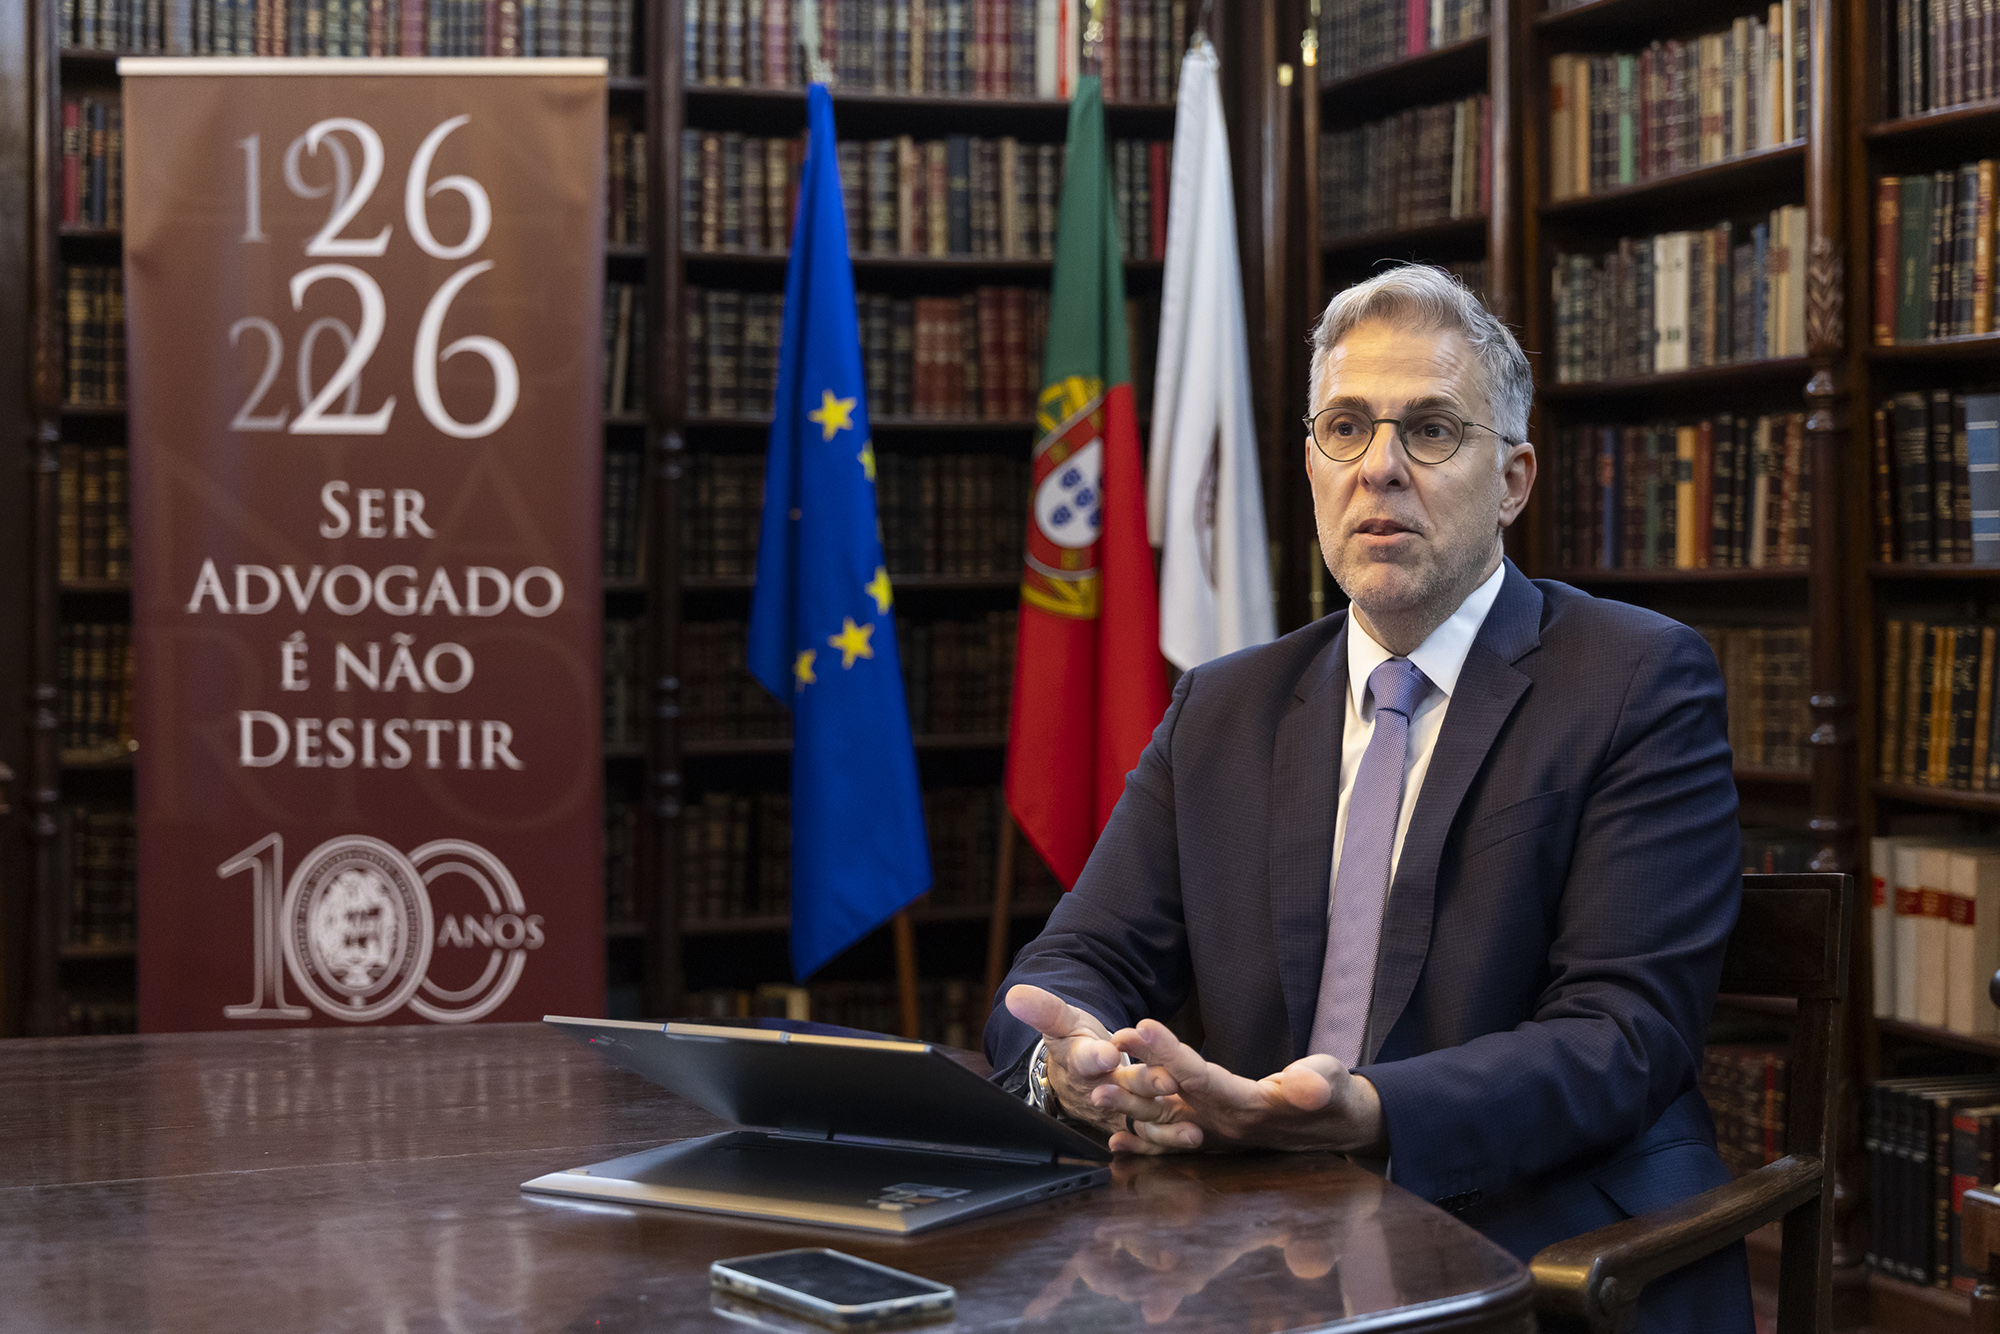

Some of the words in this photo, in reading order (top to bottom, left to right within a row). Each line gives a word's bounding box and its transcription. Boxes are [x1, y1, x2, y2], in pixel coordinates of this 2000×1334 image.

[318, 481, 436, 539] SER
[187, 558, 564, 618] ADVOGADO
[280, 630, 310, 692] É
[334, 632, 475, 693] NÃO
[237, 710, 524, 771] DESISTIR
[437, 913, 545, 949] ANOS
